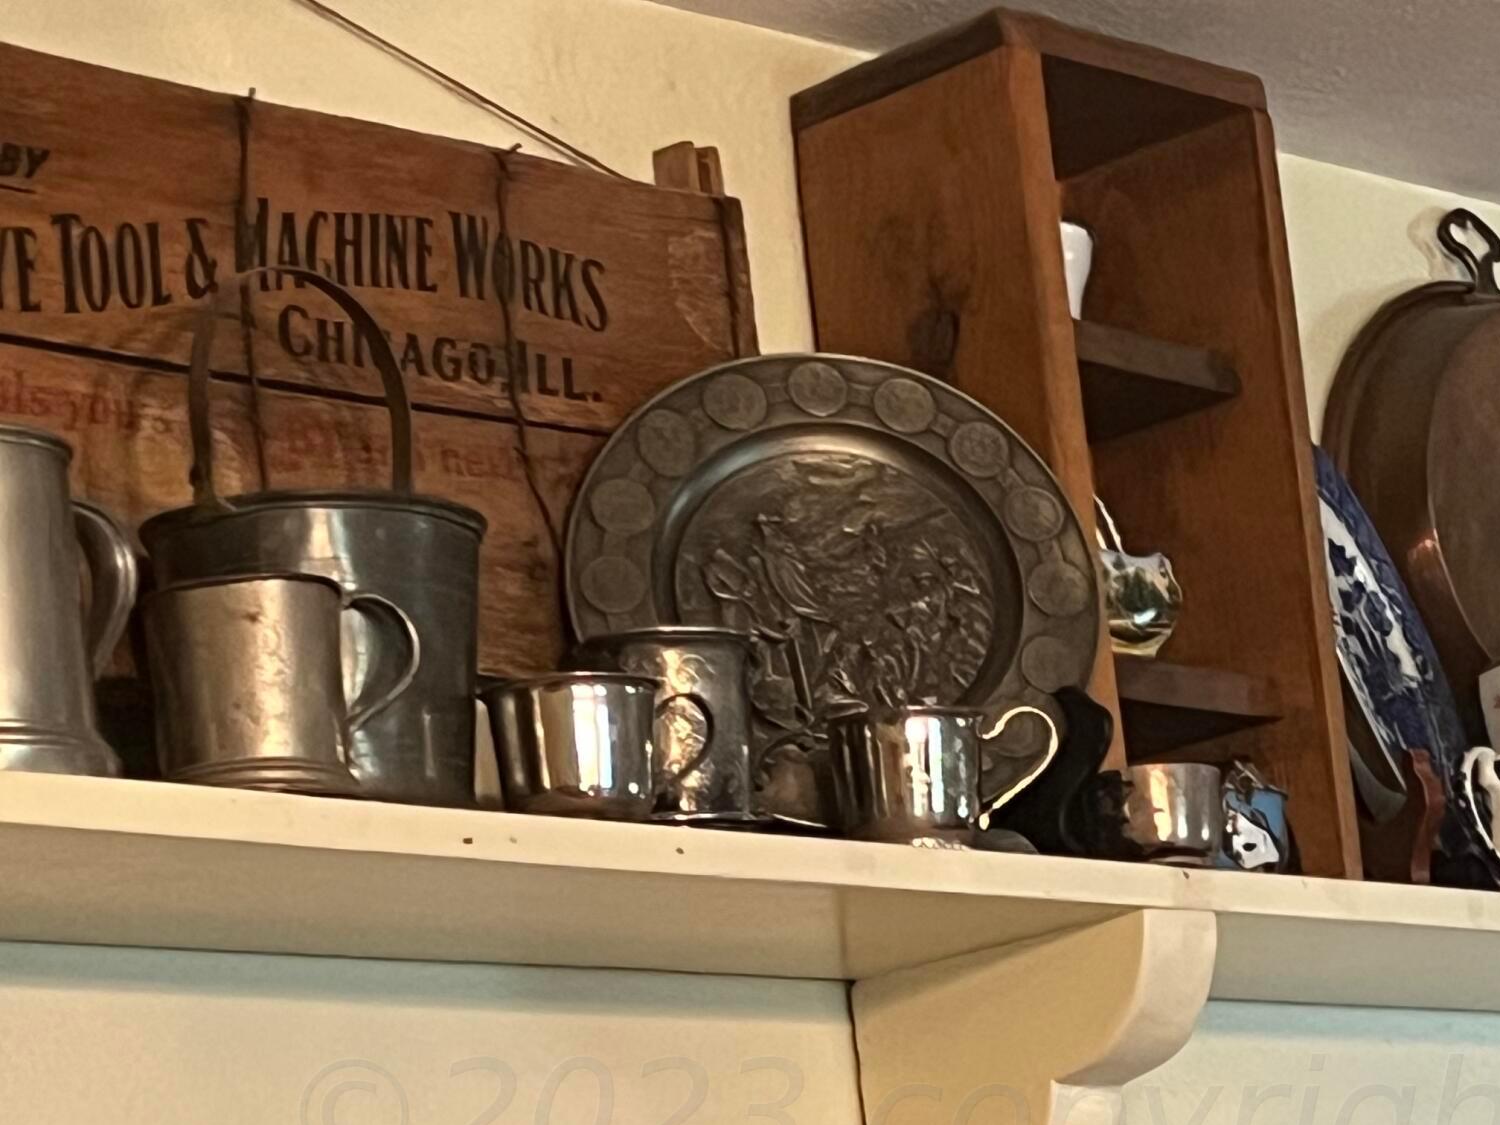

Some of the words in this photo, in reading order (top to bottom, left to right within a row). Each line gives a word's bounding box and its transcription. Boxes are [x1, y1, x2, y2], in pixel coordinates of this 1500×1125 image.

[0, 226, 41, 312] E
[50, 213, 172, 314] TOOL
[184, 217, 219, 300] &
[235, 197, 437, 293] MACHINE
[448, 210, 608, 332] WORKS
